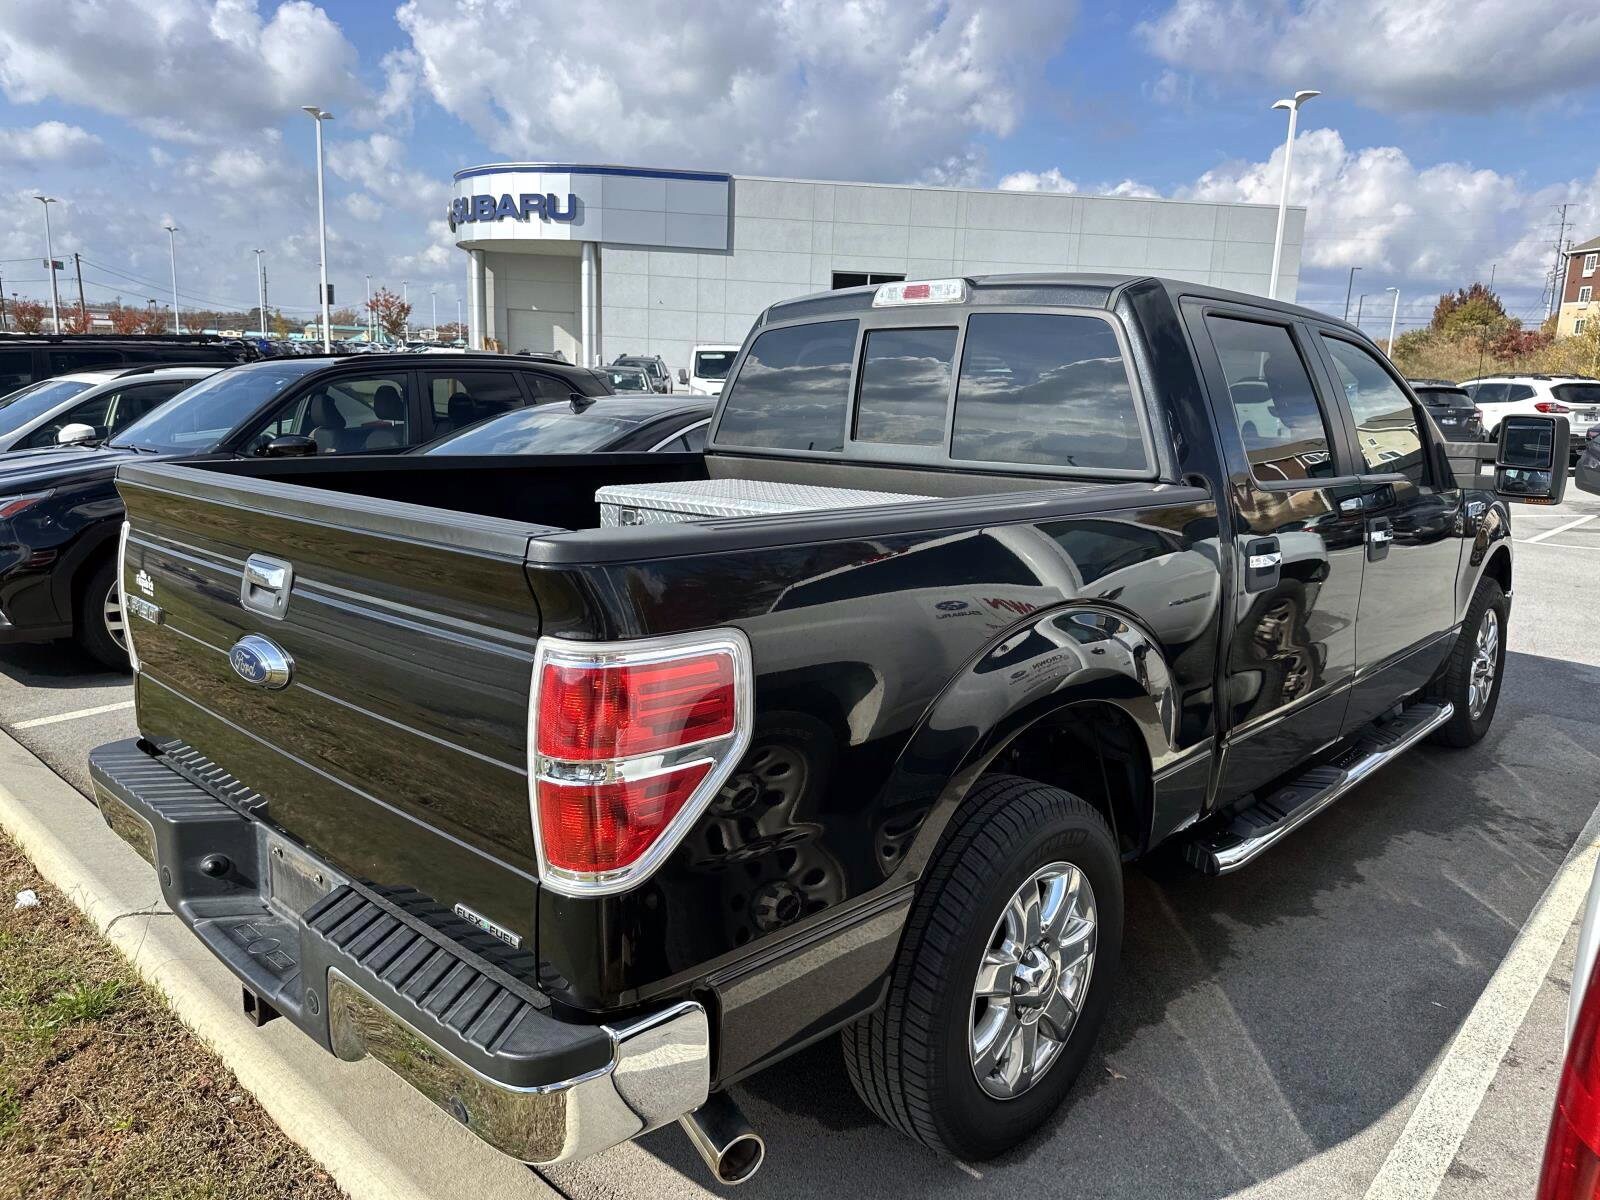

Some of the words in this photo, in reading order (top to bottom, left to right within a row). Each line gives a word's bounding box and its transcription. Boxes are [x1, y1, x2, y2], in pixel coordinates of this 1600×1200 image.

[451, 193, 577, 224] SUBARU
[233, 650, 257, 678] Ford
[456, 907, 482, 927] FLEX
[489, 925, 517, 947] FUEL
